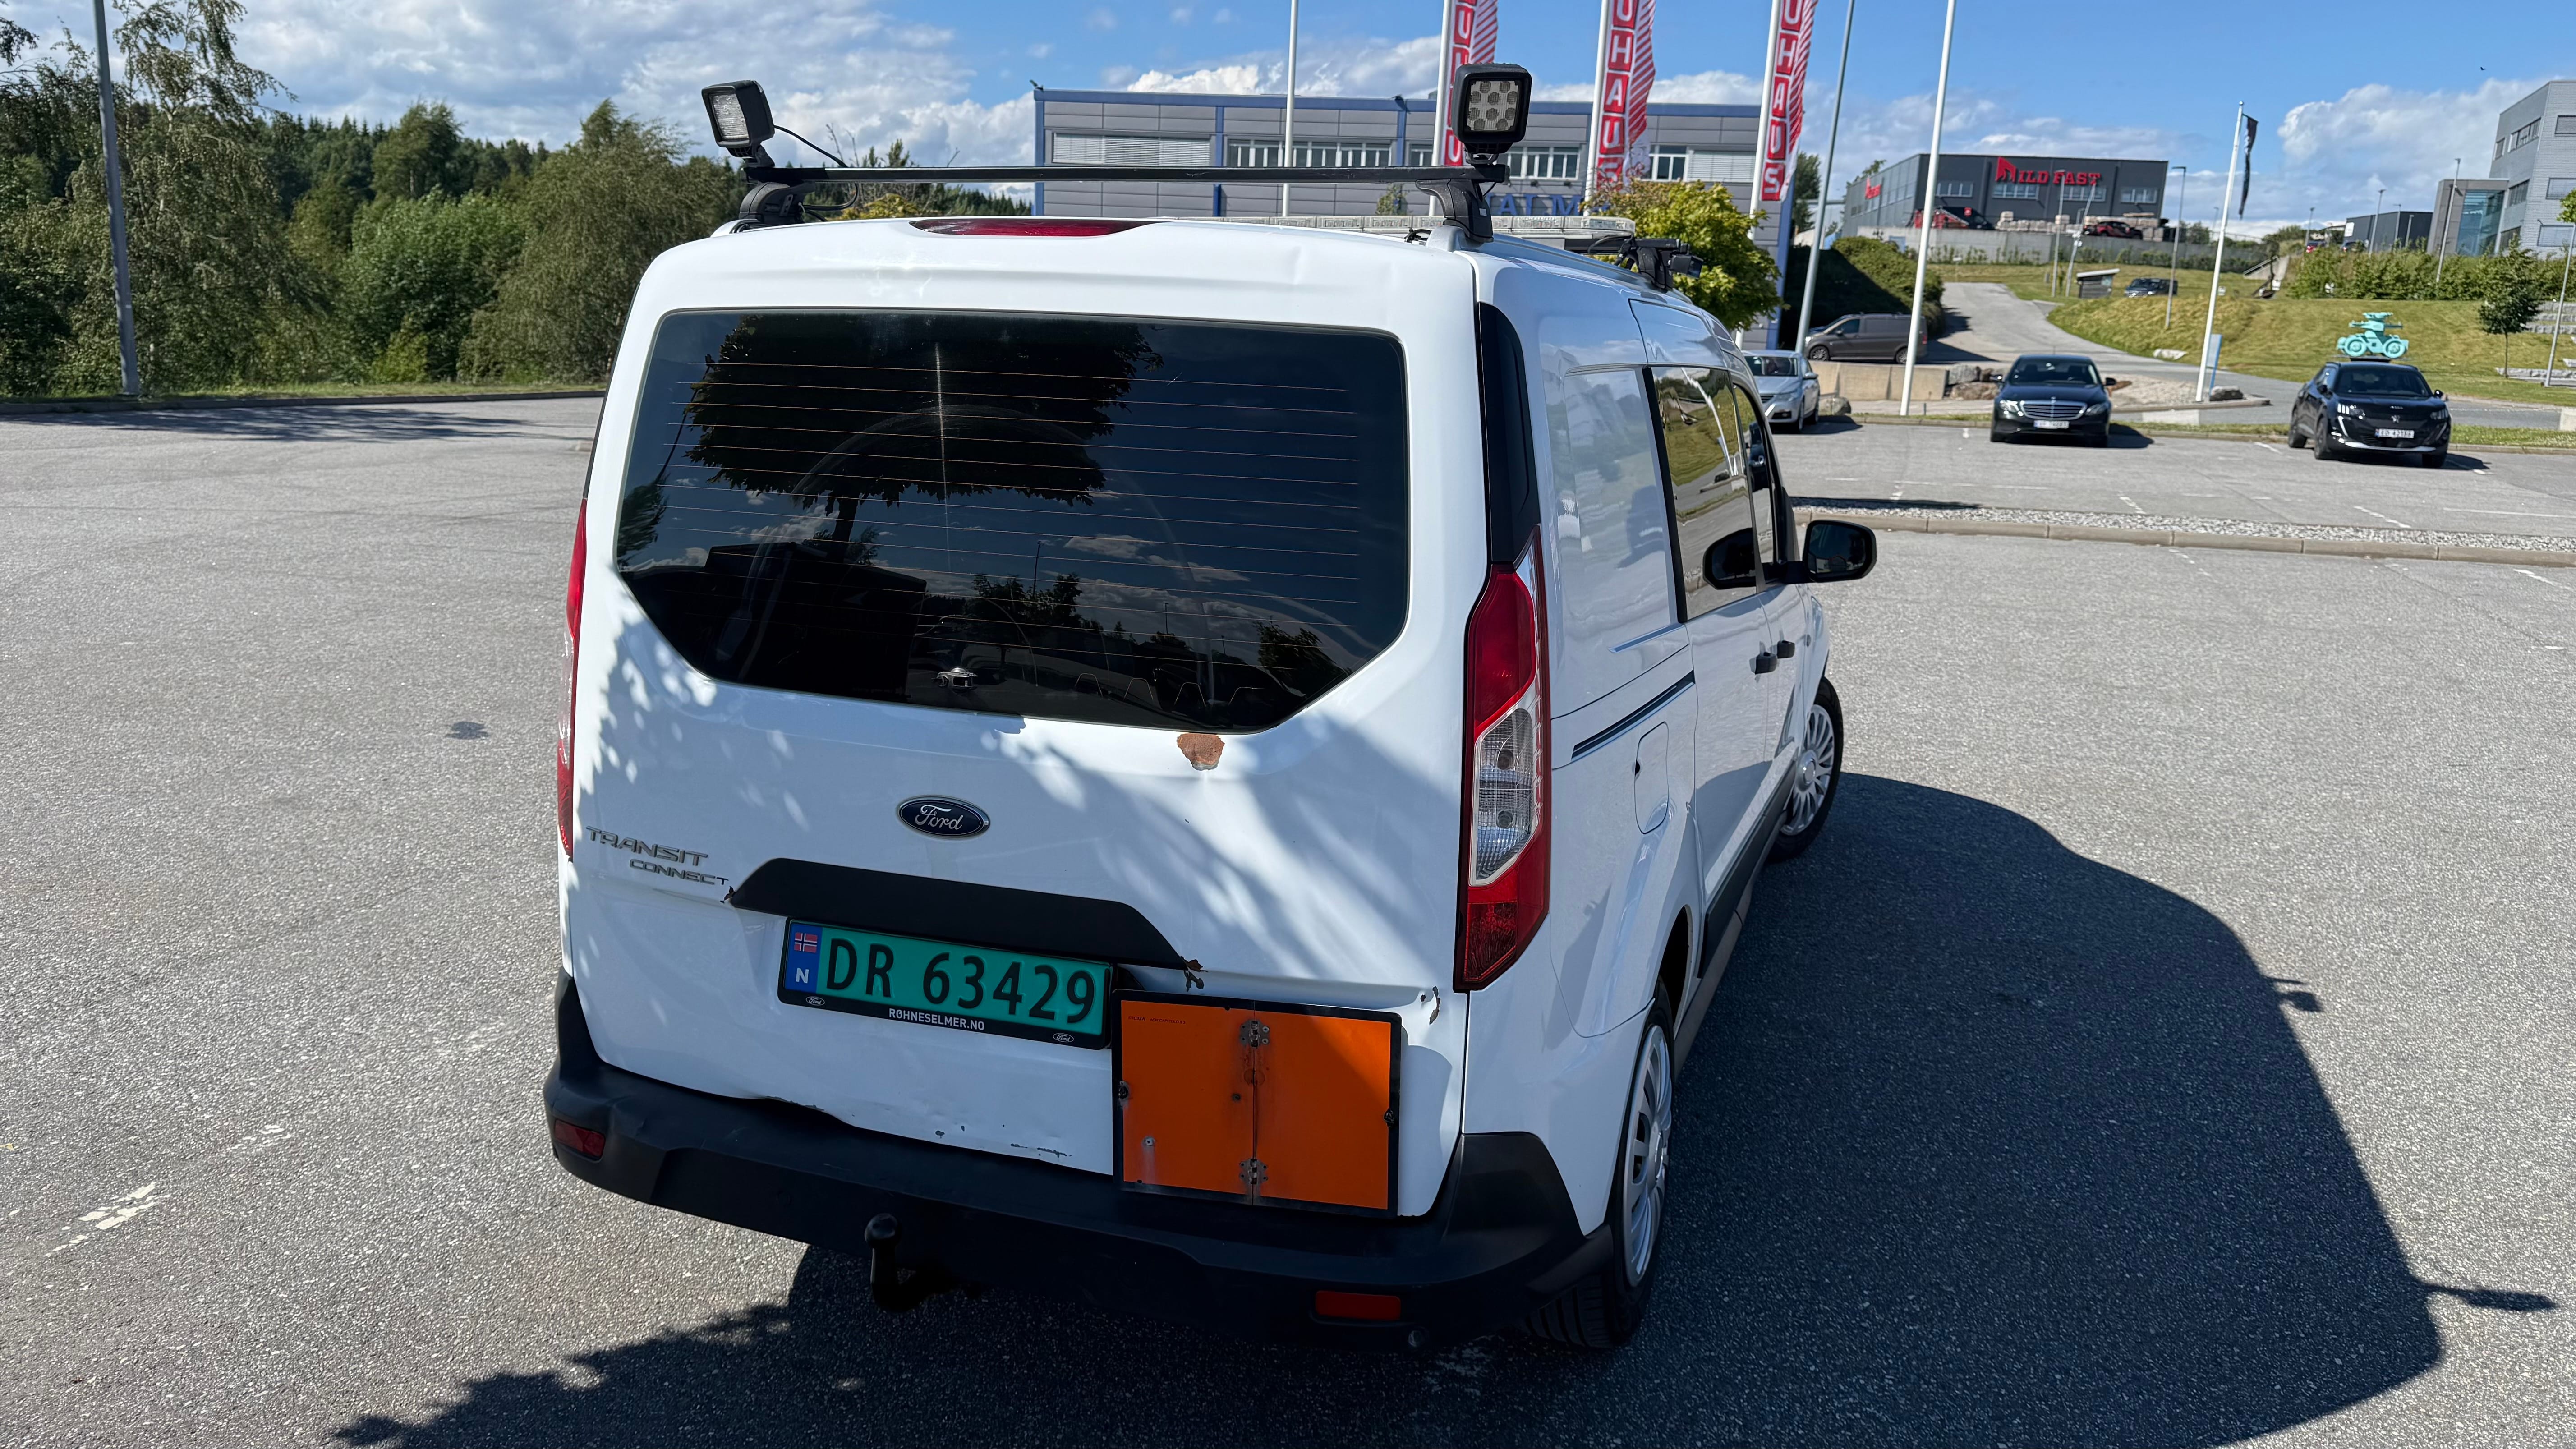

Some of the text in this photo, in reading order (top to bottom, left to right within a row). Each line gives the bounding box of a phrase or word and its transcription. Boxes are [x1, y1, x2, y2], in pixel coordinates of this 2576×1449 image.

[2019, 170, 2101, 185] ILD FAST
[915, 805, 964, 830] Ford
[586, 826, 708, 866] TRANSIT
[630, 859, 729, 885] CONNECT
[796, 968, 809, 984] N
[826, 938, 1096, 1024] DR 63429
[889, 1008, 985, 1030] RØHNESELMER.NO
